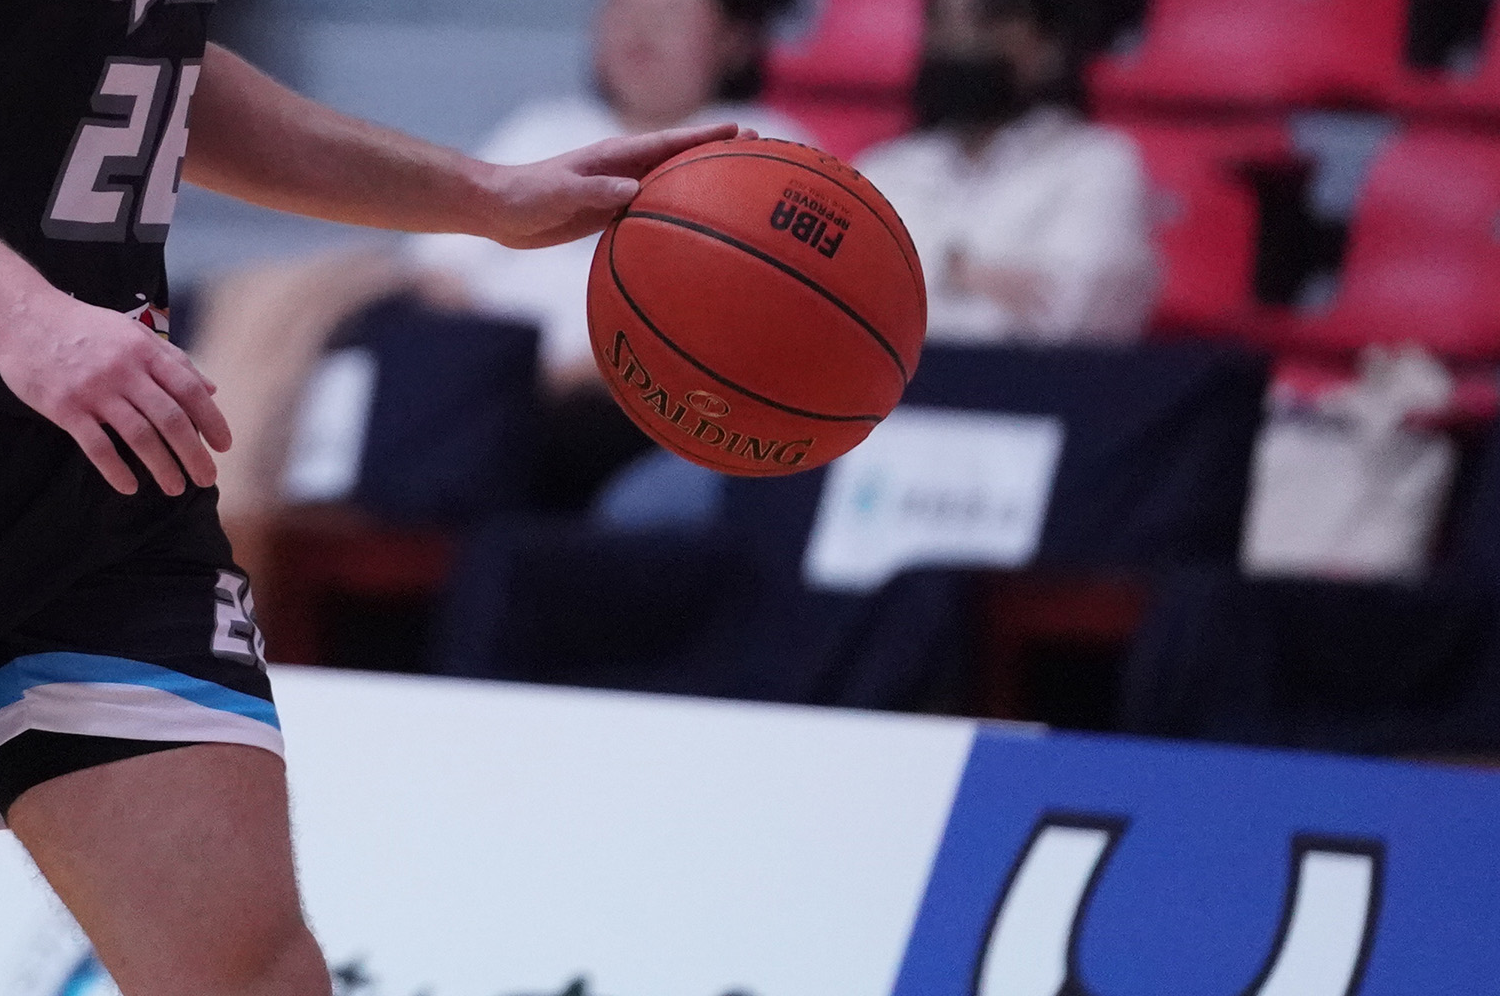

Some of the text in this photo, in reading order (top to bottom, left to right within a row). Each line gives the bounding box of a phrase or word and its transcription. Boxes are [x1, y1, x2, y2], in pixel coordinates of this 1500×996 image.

[769, 199, 845, 259] FIBA
[782, 187, 851, 231] APPROVED
[604, 329, 817, 466] SPALDING
[211, 570, 267, 668] 2
